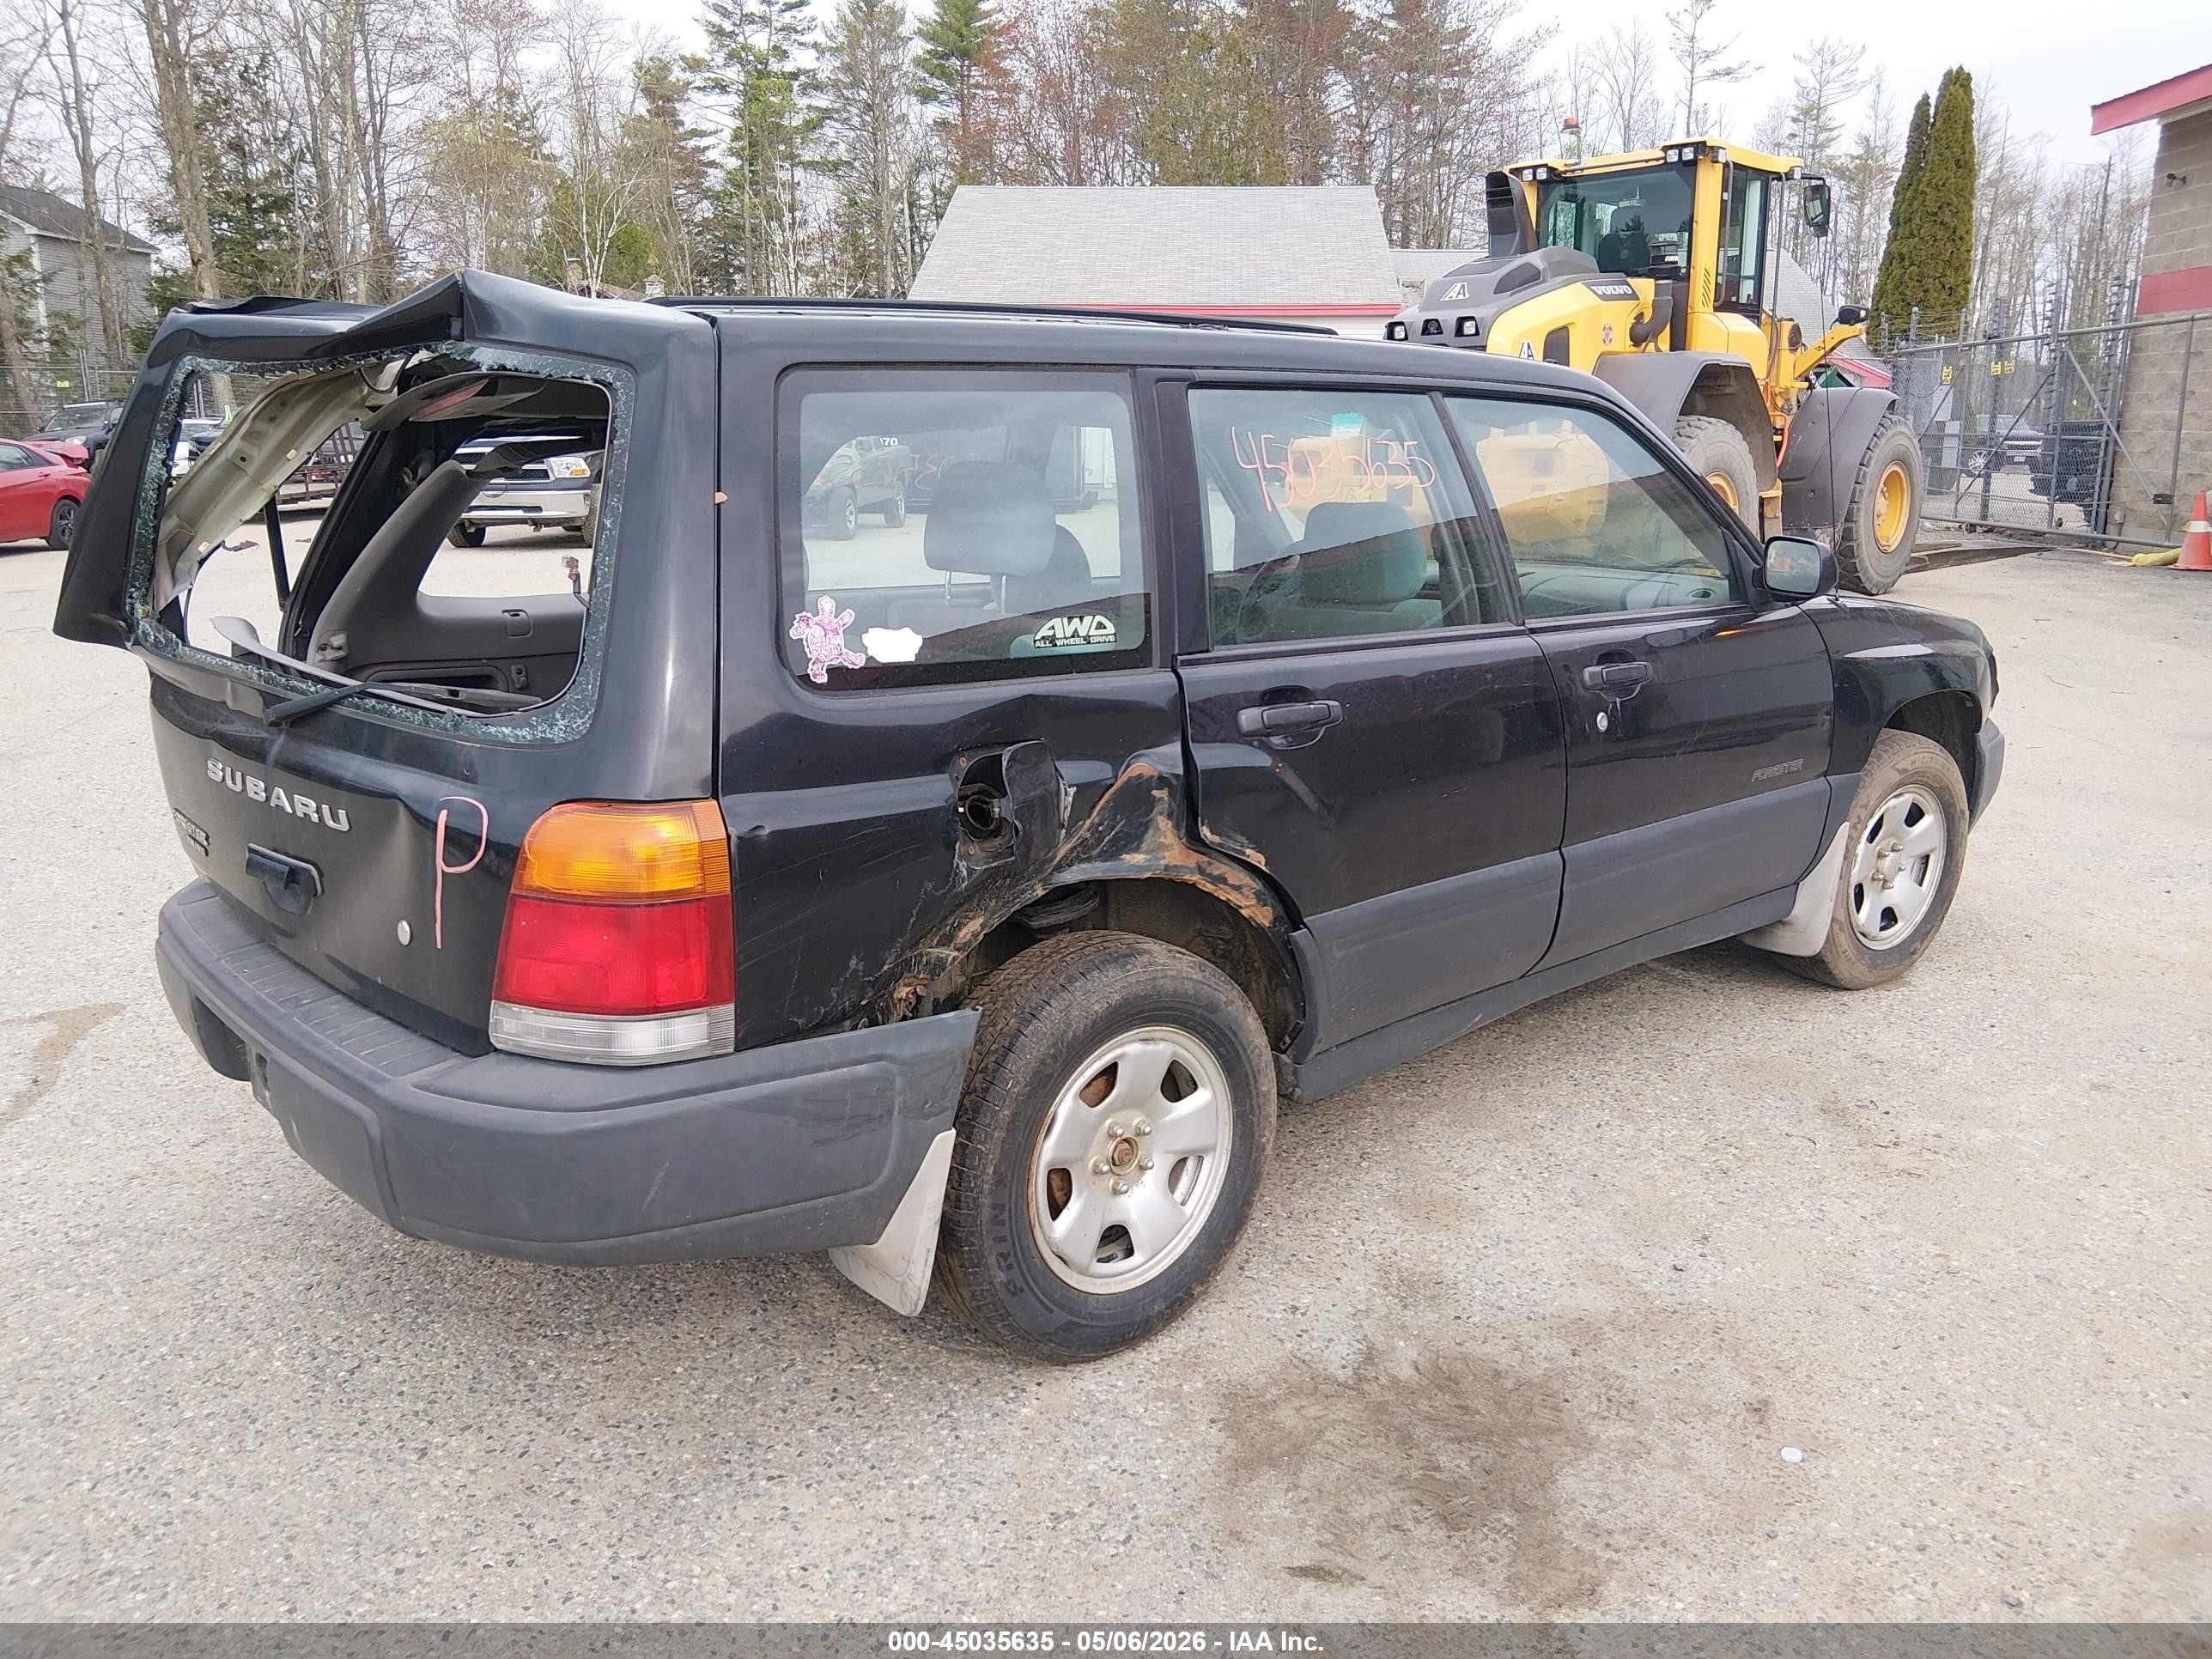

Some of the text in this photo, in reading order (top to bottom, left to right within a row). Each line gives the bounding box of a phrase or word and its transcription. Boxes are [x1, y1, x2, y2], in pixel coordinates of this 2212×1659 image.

[1590, 285, 1632, 295] VOLVO
[1034, 615, 1115, 641] AWD
[1035, 635, 1116, 648] ALL WHEEL DRIVE
[207, 757, 351, 832] SUBARU
[434, 796, 489, 949] P
